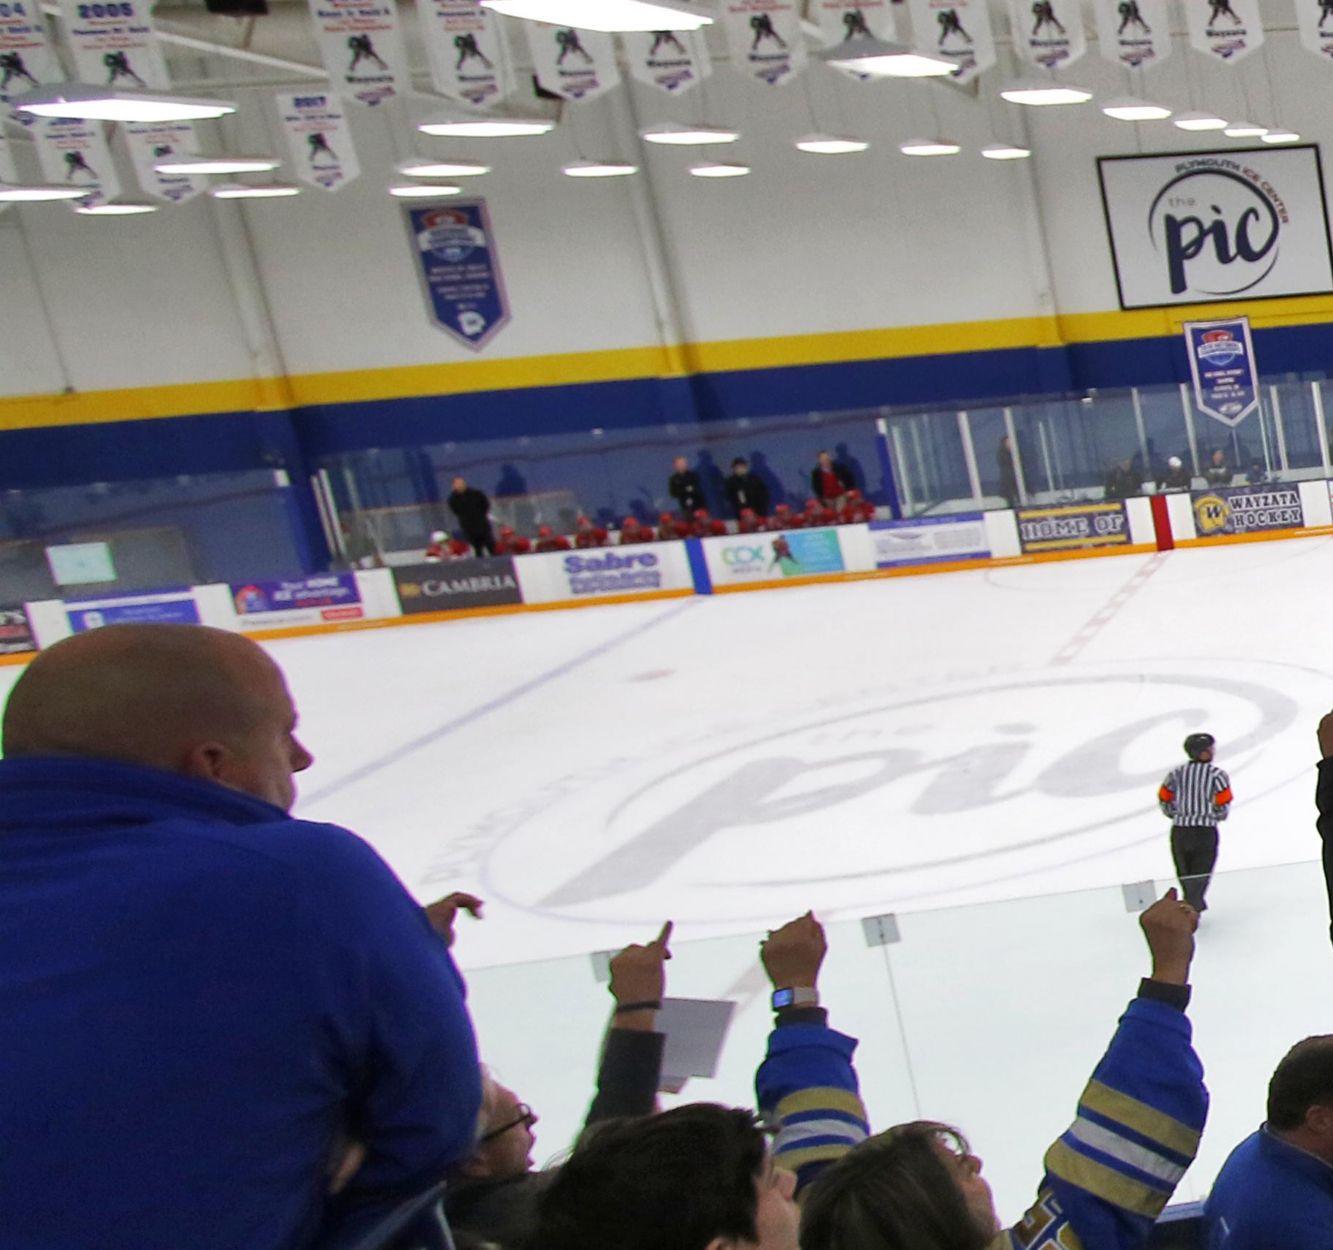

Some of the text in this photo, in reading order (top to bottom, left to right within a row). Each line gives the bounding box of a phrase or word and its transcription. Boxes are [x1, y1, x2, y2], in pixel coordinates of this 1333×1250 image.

[1164, 204, 1269, 295] pic
[1206, 505, 1221, 519] W
[1228, 491, 1299, 511] WAYZATA
[1020, 514, 1125, 541] HOME OF
[1232, 507, 1302, 528] HOCKEY
[564, 551, 658, 574] Sabre
[423, 574, 516, 597] CAMBRIA
